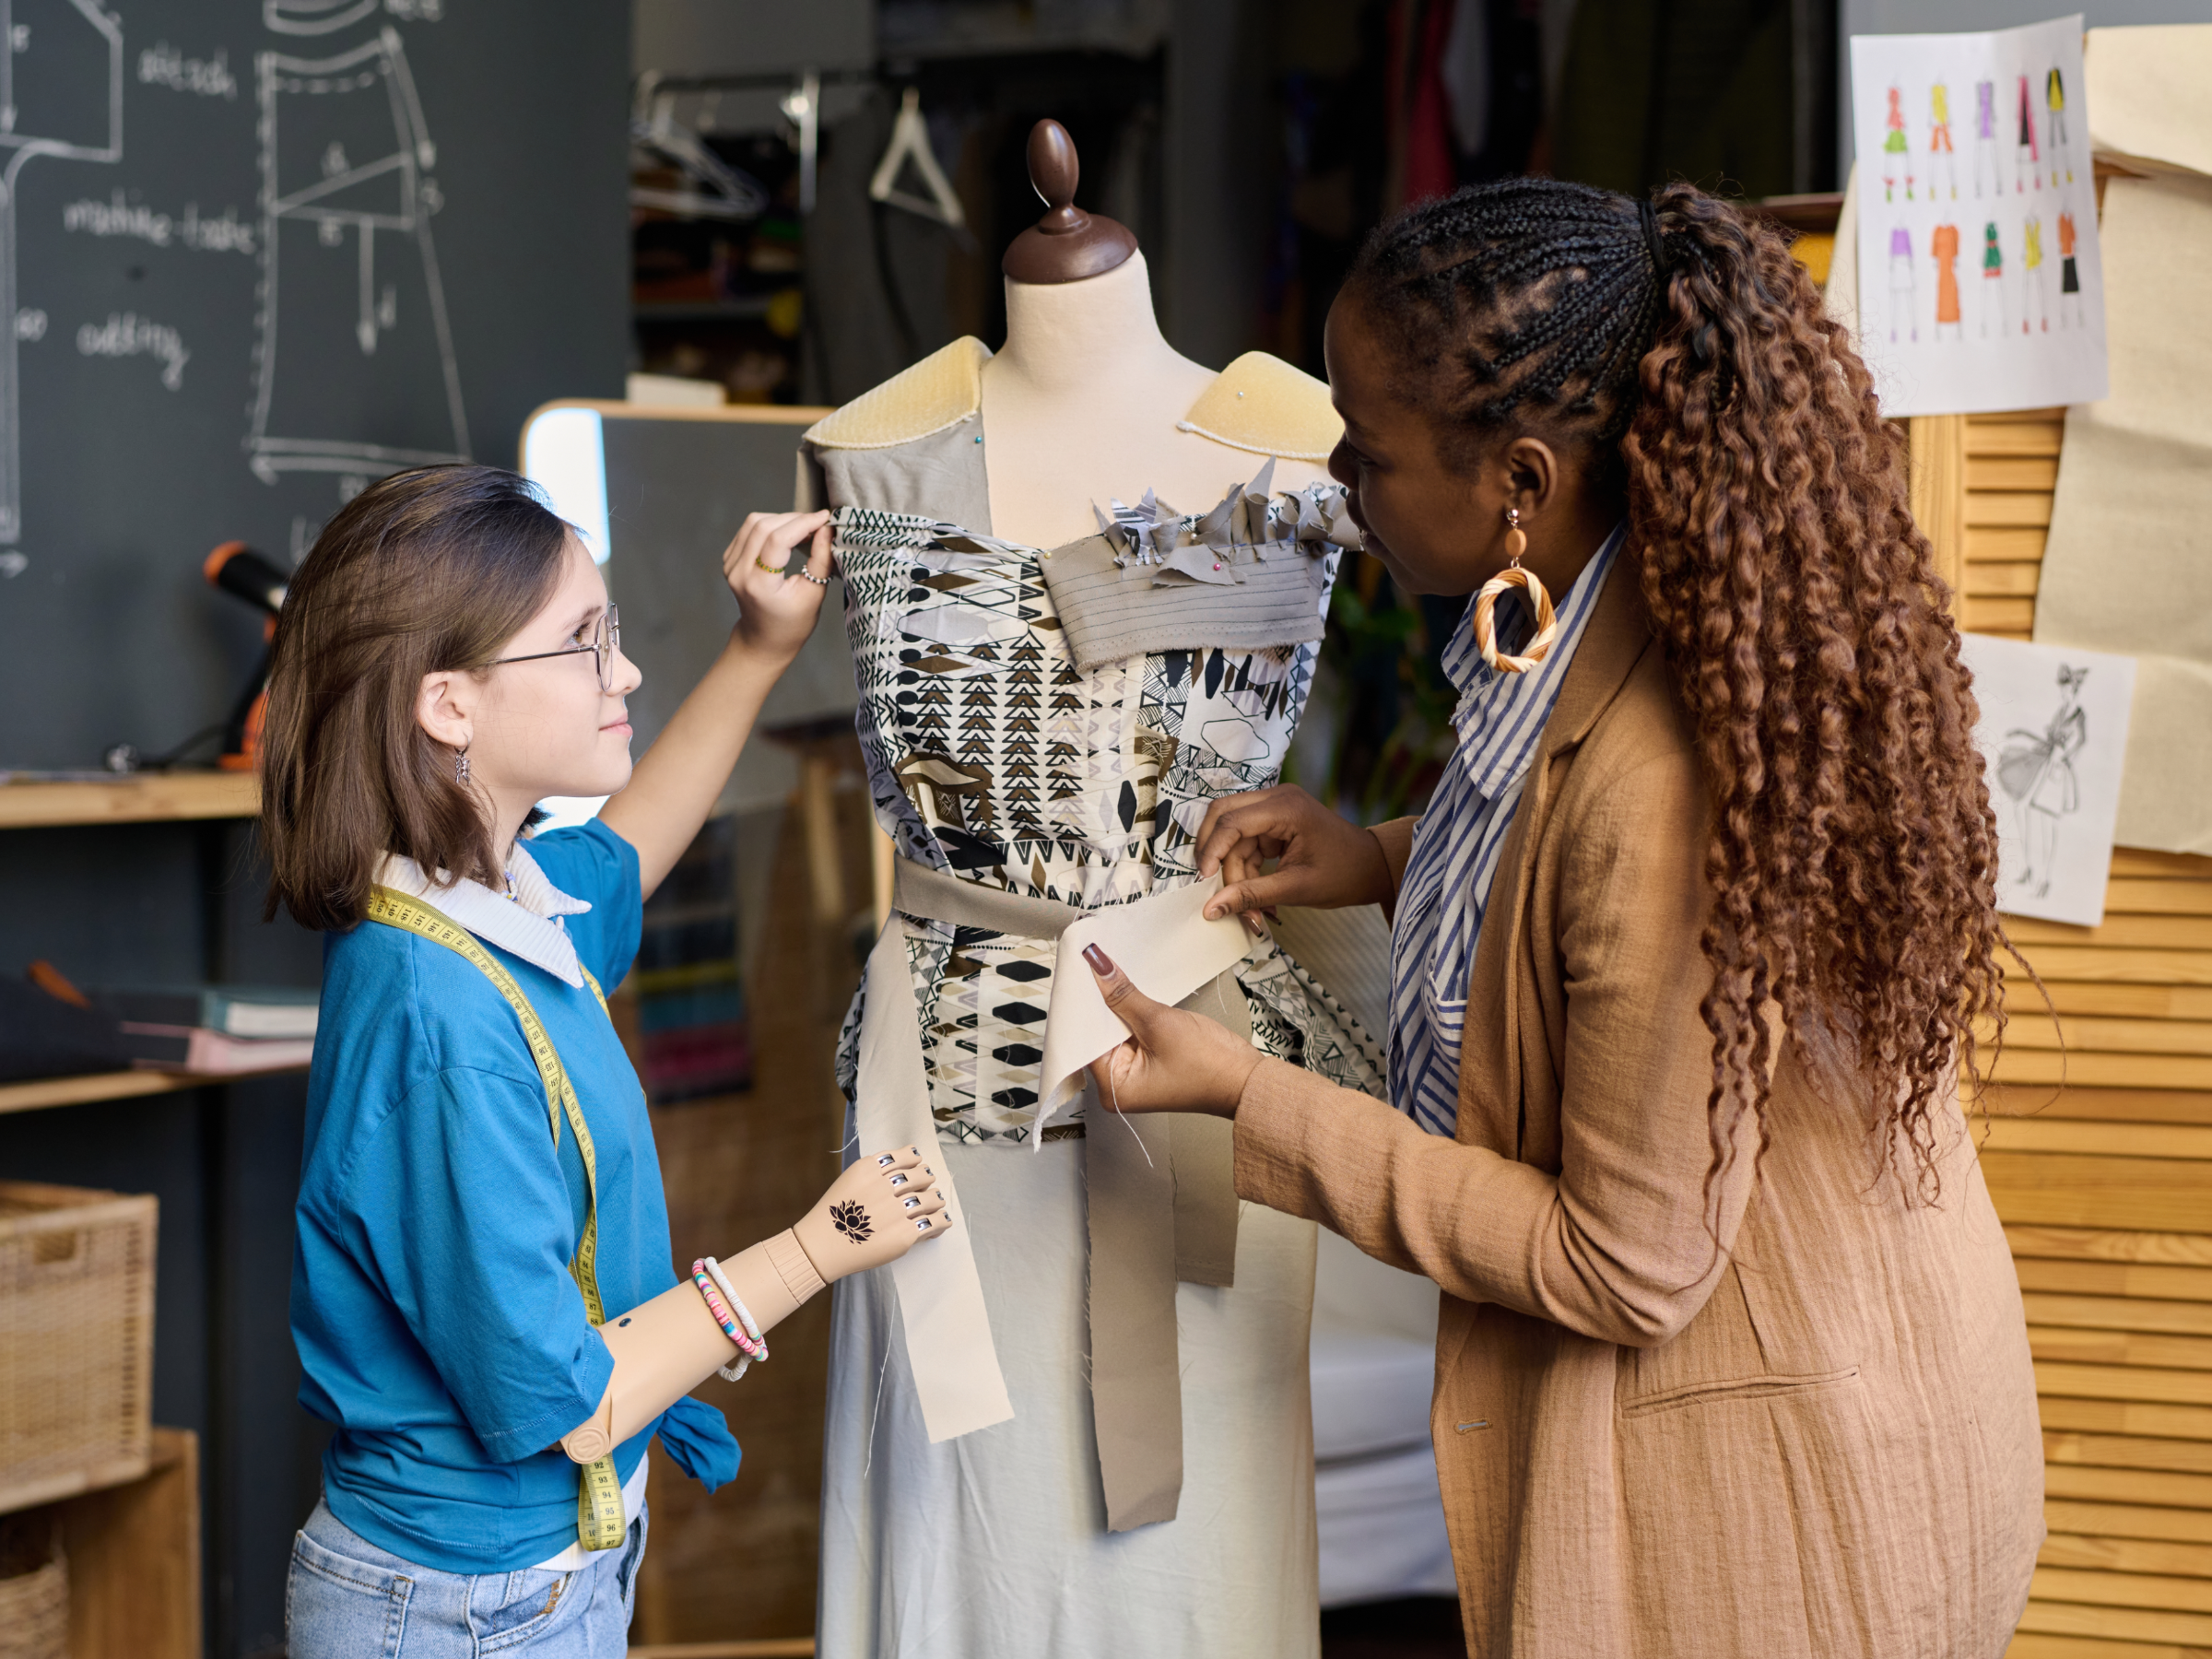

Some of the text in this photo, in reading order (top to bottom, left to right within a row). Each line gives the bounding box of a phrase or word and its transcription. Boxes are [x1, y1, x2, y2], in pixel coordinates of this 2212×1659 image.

[388, 904, 398, 917] 149
[401, 908, 412, 921] 148
[414, 914, 425, 926] 147
[428, 922, 440, 933] 146
[442, 930, 454, 940] 145
[456, 938, 468, 947] 144
[532, 1030, 541, 1041] 137
[538, 1046, 548, 1056] 136
[545, 1061, 555, 1072] 135
[588, 1288, 595, 1297] 86
[589, 1302, 597, 1311] 87
[590, 1318, 599, 1326] 88
